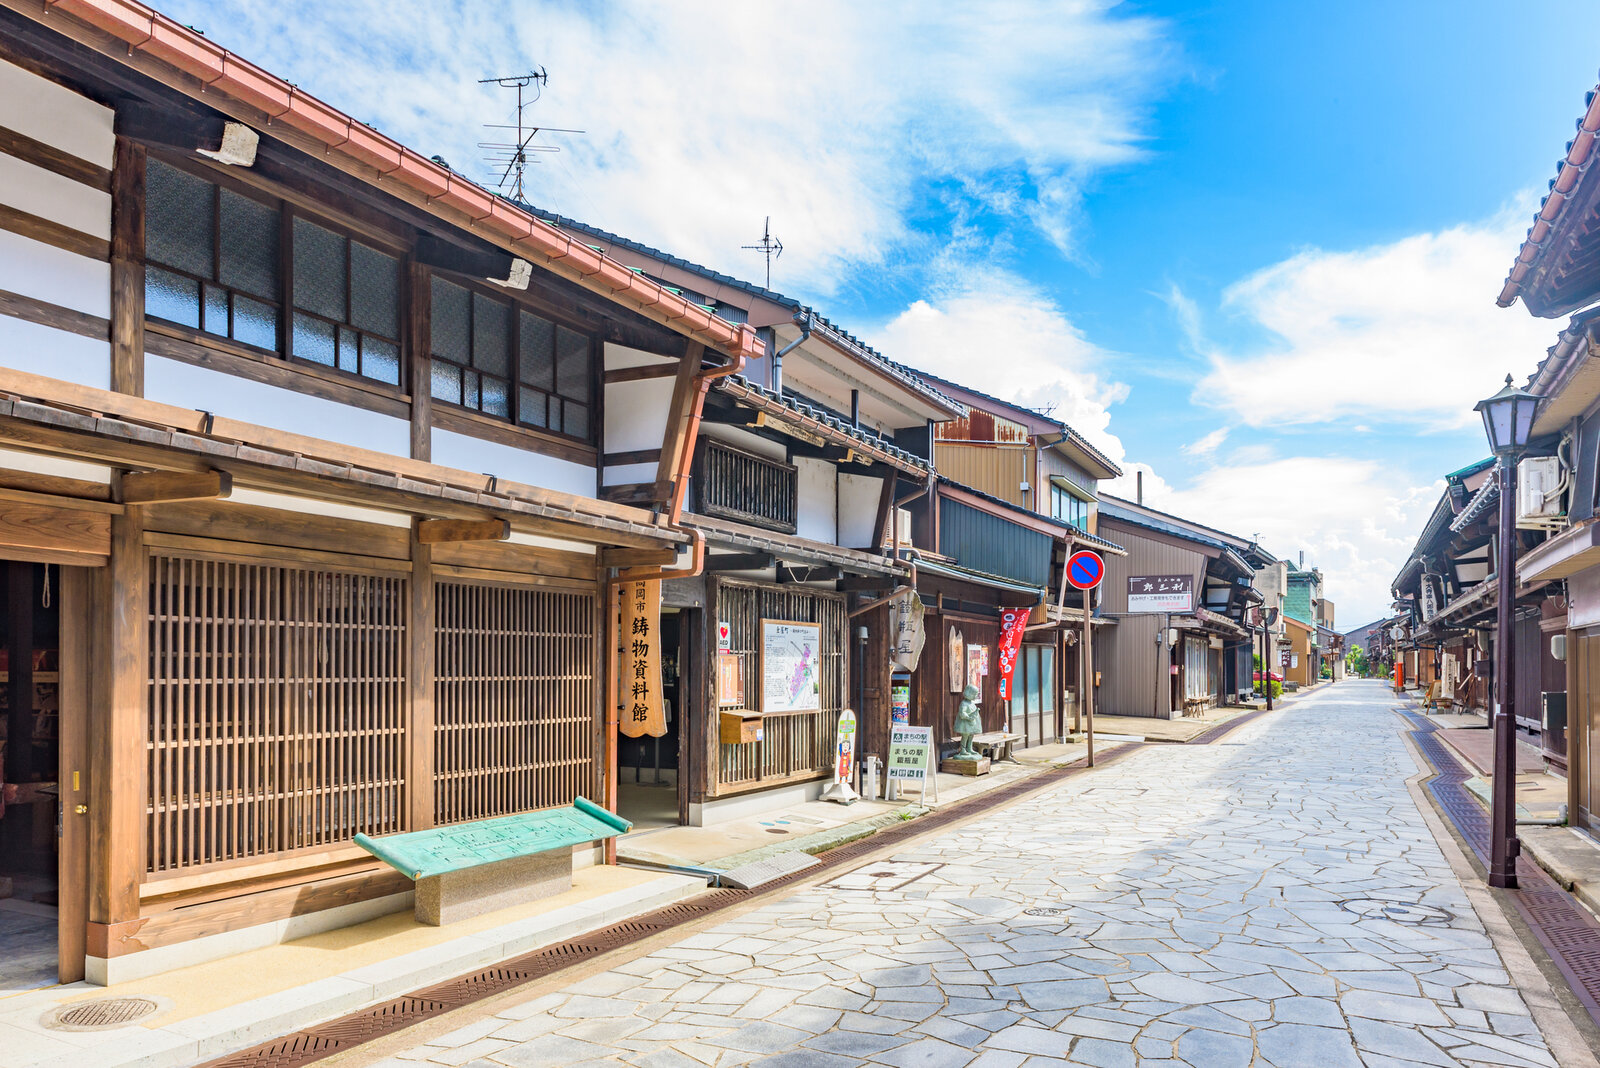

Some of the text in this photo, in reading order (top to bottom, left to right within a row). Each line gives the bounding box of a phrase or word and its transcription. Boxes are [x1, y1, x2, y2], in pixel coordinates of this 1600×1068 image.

[631, 616, 650, 722] 鋳物資料館
[894, 748, 924, 756] まちの駅
